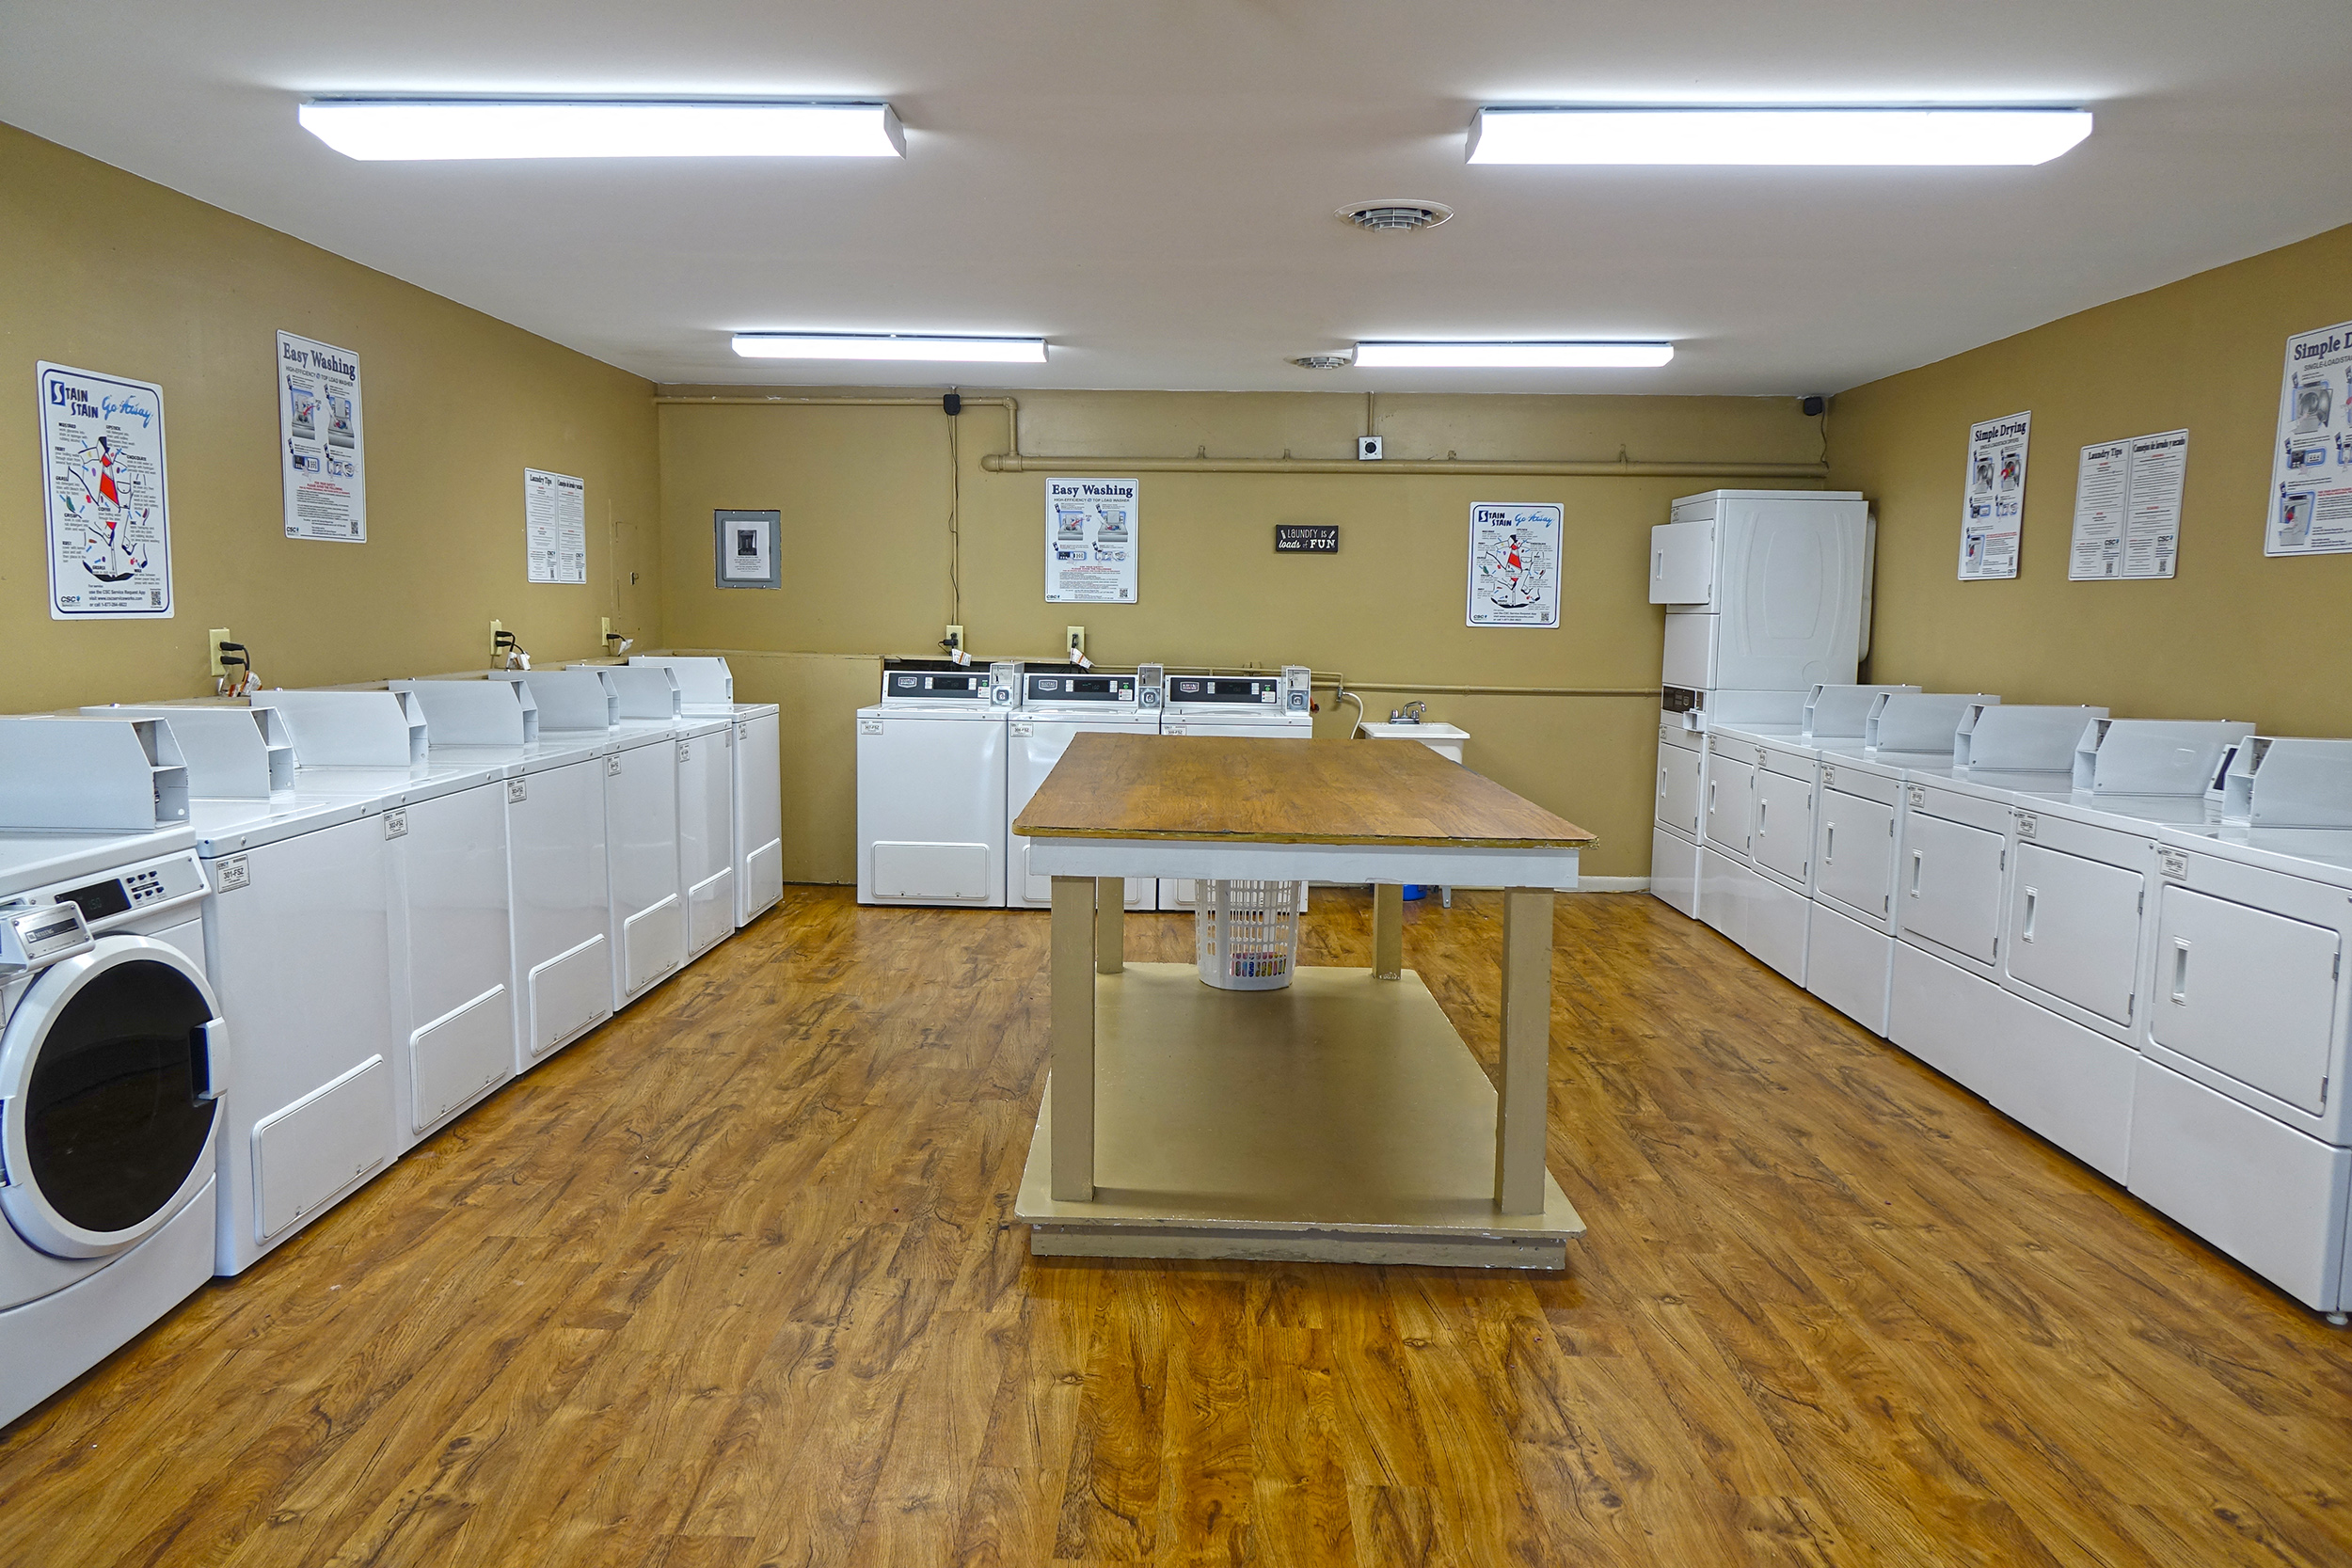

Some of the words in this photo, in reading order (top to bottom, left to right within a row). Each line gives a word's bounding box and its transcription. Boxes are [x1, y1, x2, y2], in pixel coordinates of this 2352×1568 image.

[2294, 335, 2341, 361] Simple
[283, 341, 309, 369] Easy
[310, 350, 356, 381] Washing
[51, 380, 88, 405] STAIN
[71, 402, 99, 419] STAIN
[102, 394, 118, 420] Go
[1975, 426, 1999, 442] Simple
[1999, 421, 2026, 437] Drying
[2088, 449, 2110, 460] Laundry
[2111, 447, 2122, 458] Tips
[1052, 483, 1079, 498] Easy
[1082, 483, 1133, 499] Washing
[1479, 511, 1505, 522] STAIN
[1515, 513, 1526, 527] Go
[1279, 539, 1301, 548] loads
[1310, 539, 1336, 548] FUN
